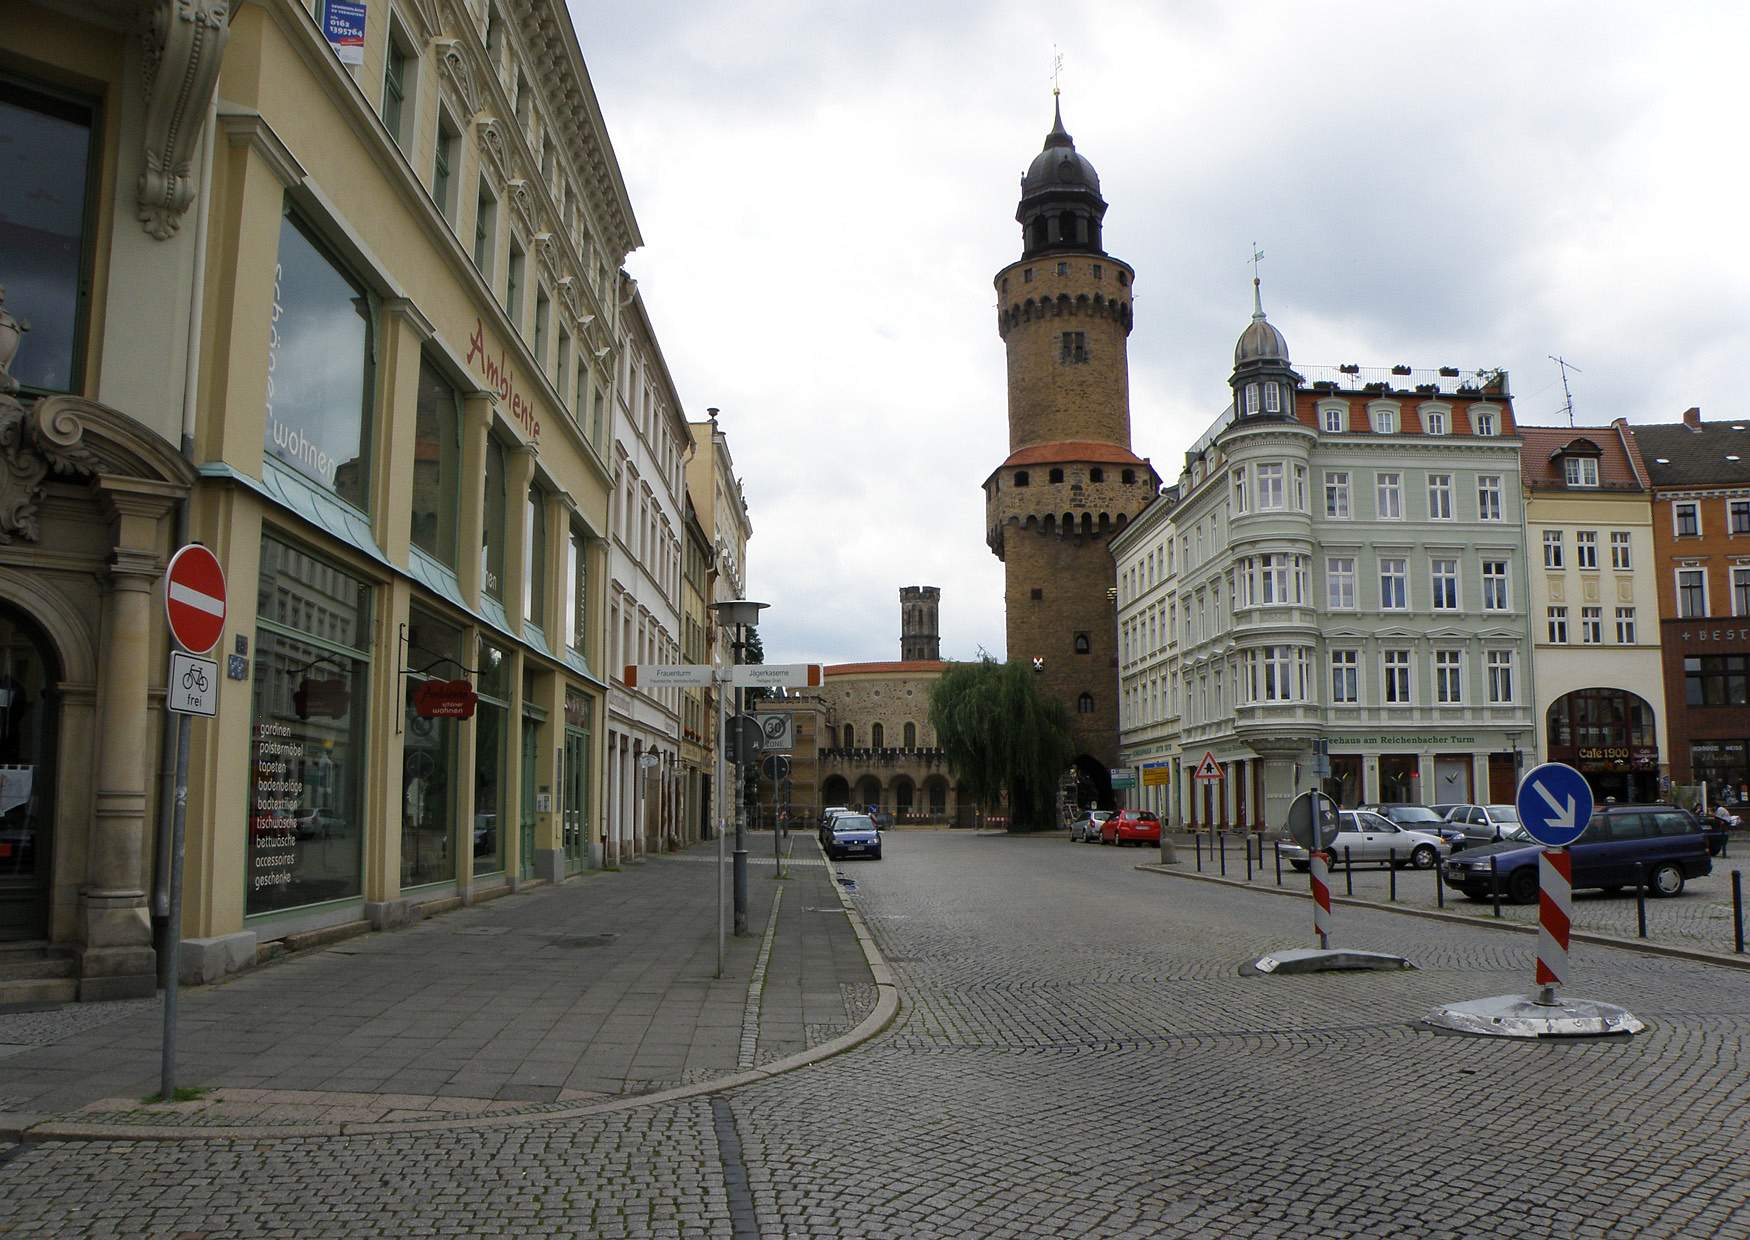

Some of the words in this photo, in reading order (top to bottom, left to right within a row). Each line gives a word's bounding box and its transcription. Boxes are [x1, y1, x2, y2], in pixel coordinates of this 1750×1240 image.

[330, 19, 350, 28] 0162
[466, 317, 541, 438] Ambiente
[273, 419, 337, 486] wohnen
[656, 669, 692, 678] Frauenturm
[187, 694, 202, 707] frei
[260, 722, 291, 738] gardinen
[767, 722, 782, 733] 30
[1328, 736, 1360, 744] eehaus
[1380, 736, 1448, 744] Reichenbacher
[1450, 735, 1475, 744] Turm
[260, 741, 304, 757] polstermöbel
[1604, 747, 1629, 758] 1900
[259, 760, 287, 776] tapeten
[258, 777, 303, 795] bodenbeläge
[257, 814, 298, 829] tischwäsche
[256, 834, 296, 848] bettwäsche
[256, 851, 295, 867] accessoires
[255, 869, 291, 891] geschenke
